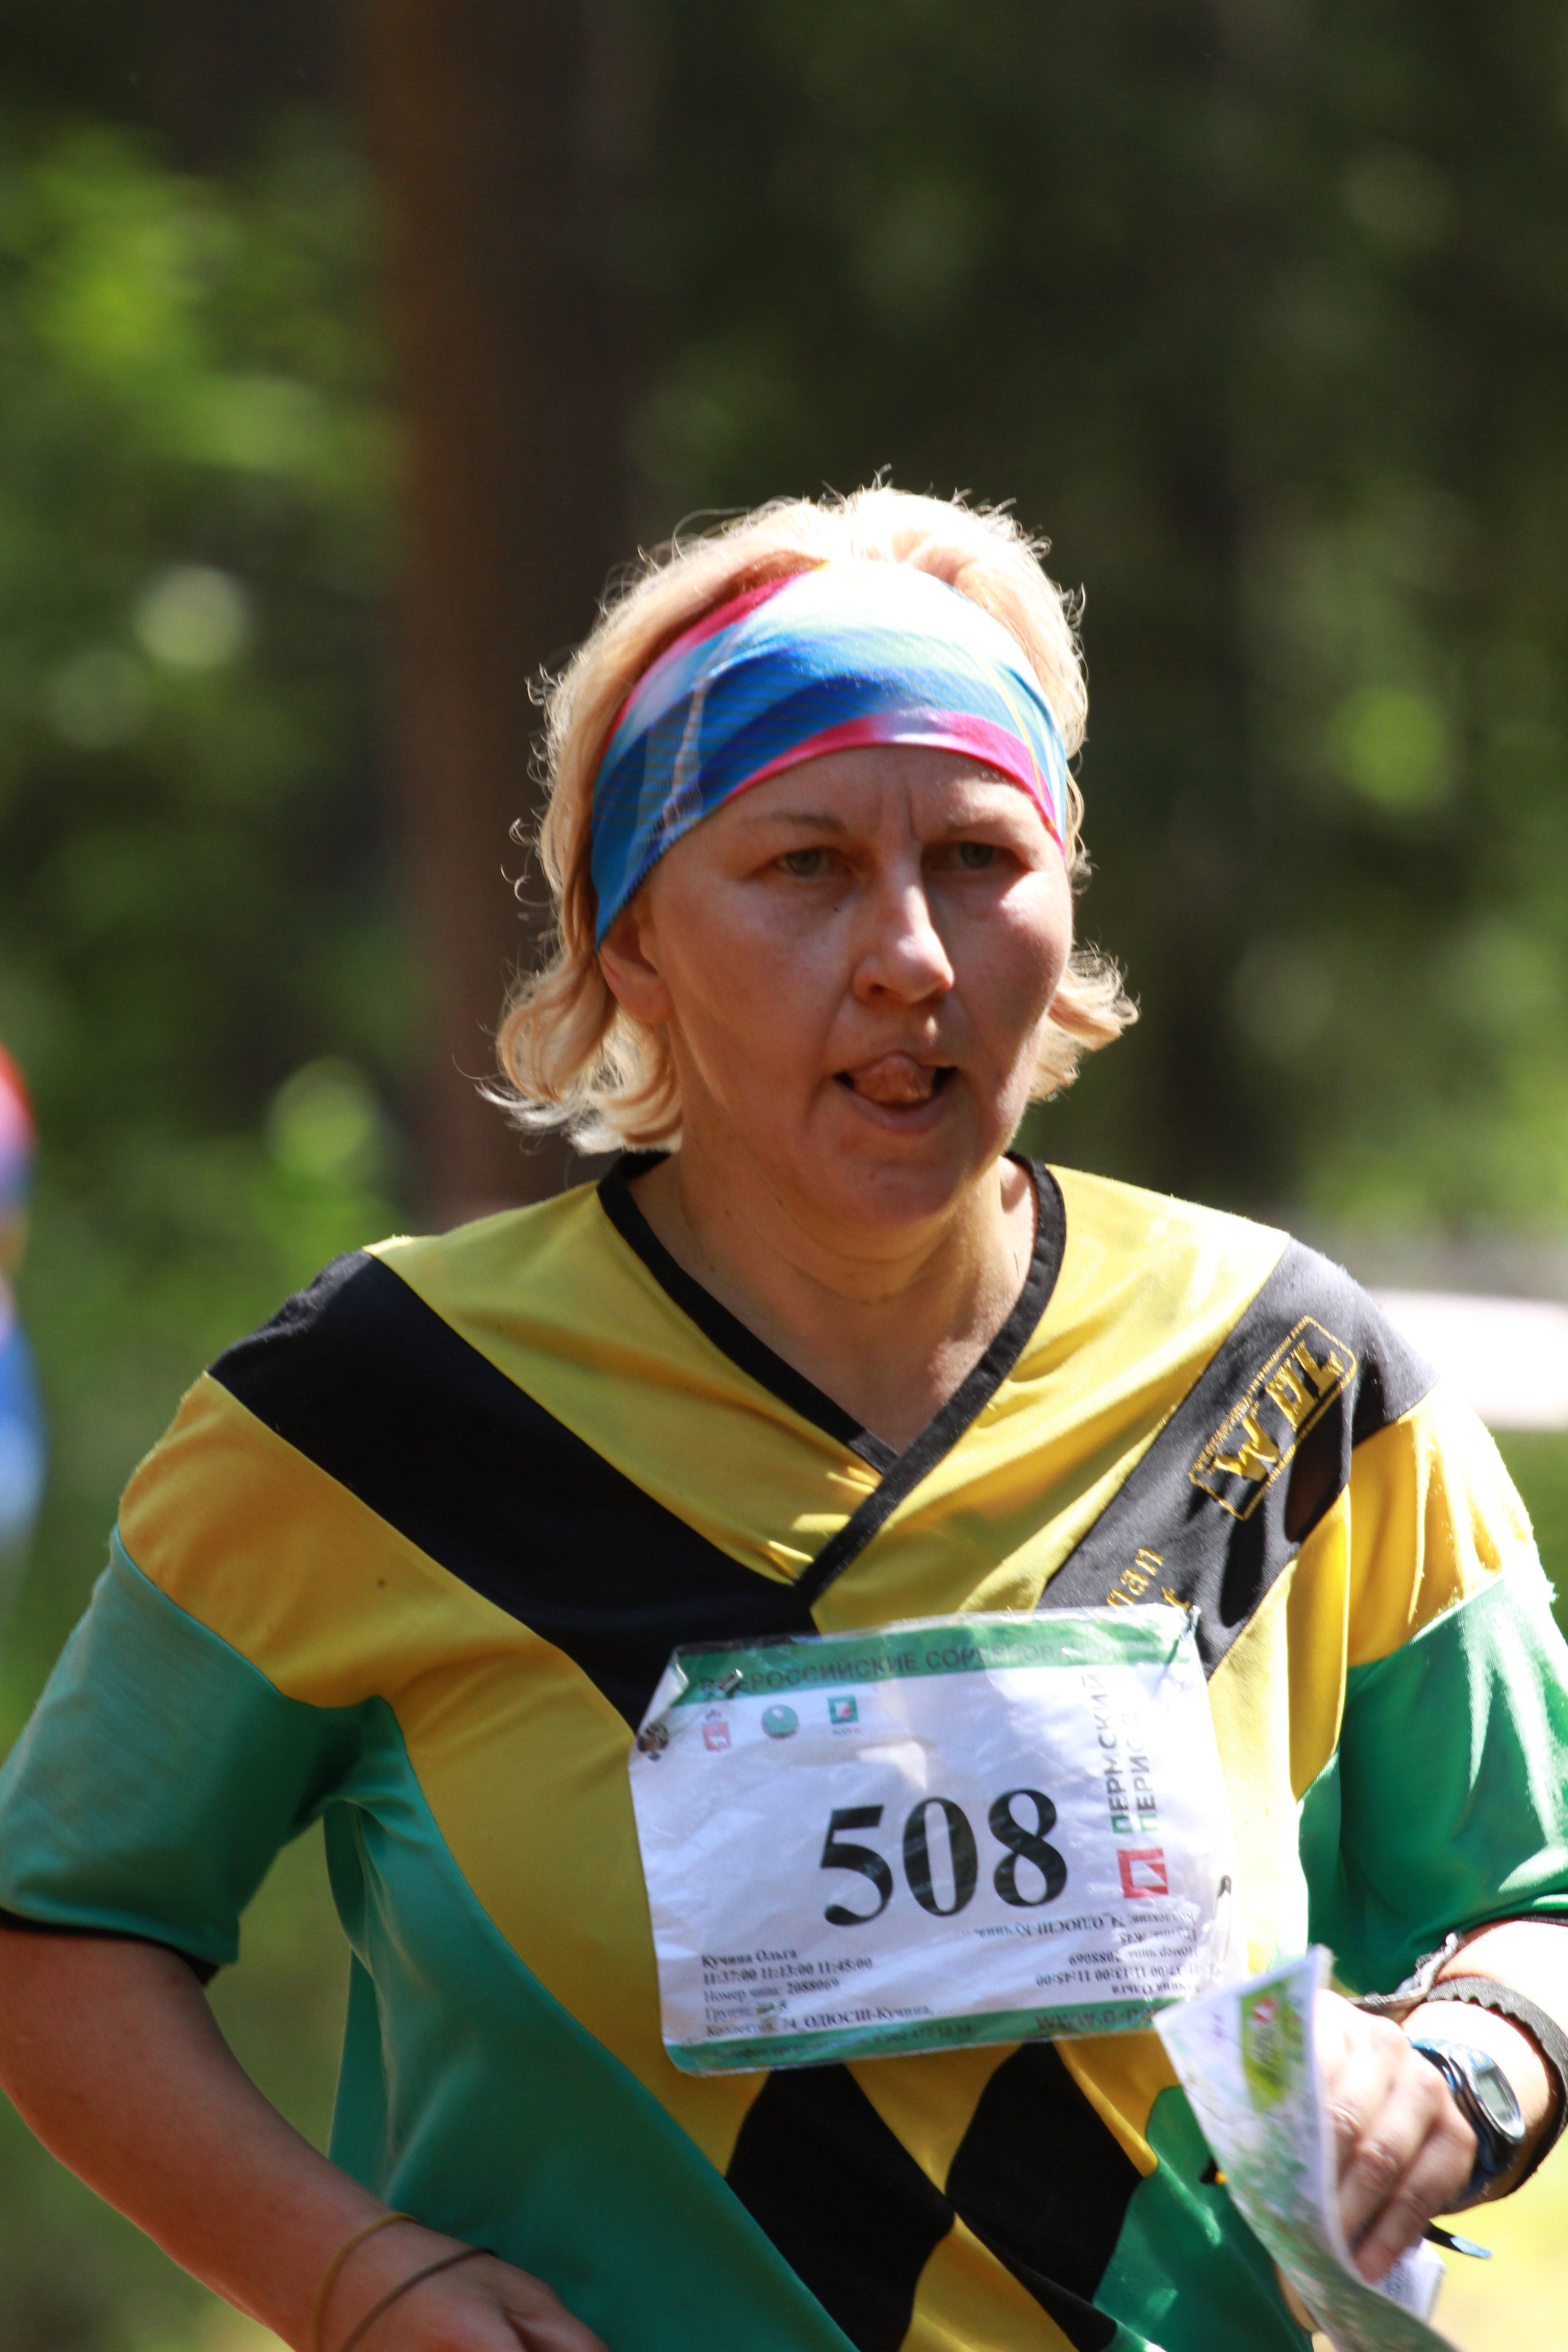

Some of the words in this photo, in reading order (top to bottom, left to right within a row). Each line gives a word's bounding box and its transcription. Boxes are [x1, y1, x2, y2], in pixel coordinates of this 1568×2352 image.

[700, 1651, 918, 1695] ВЕРОССИЙСКИЕ
[1080, 1673, 1133, 1834] ПЕРМСКИЙ
[820, 1787, 1067, 1927] 508
[702, 1953, 753, 1970] Кучина
[755, 1948, 797, 1963] Ольга
